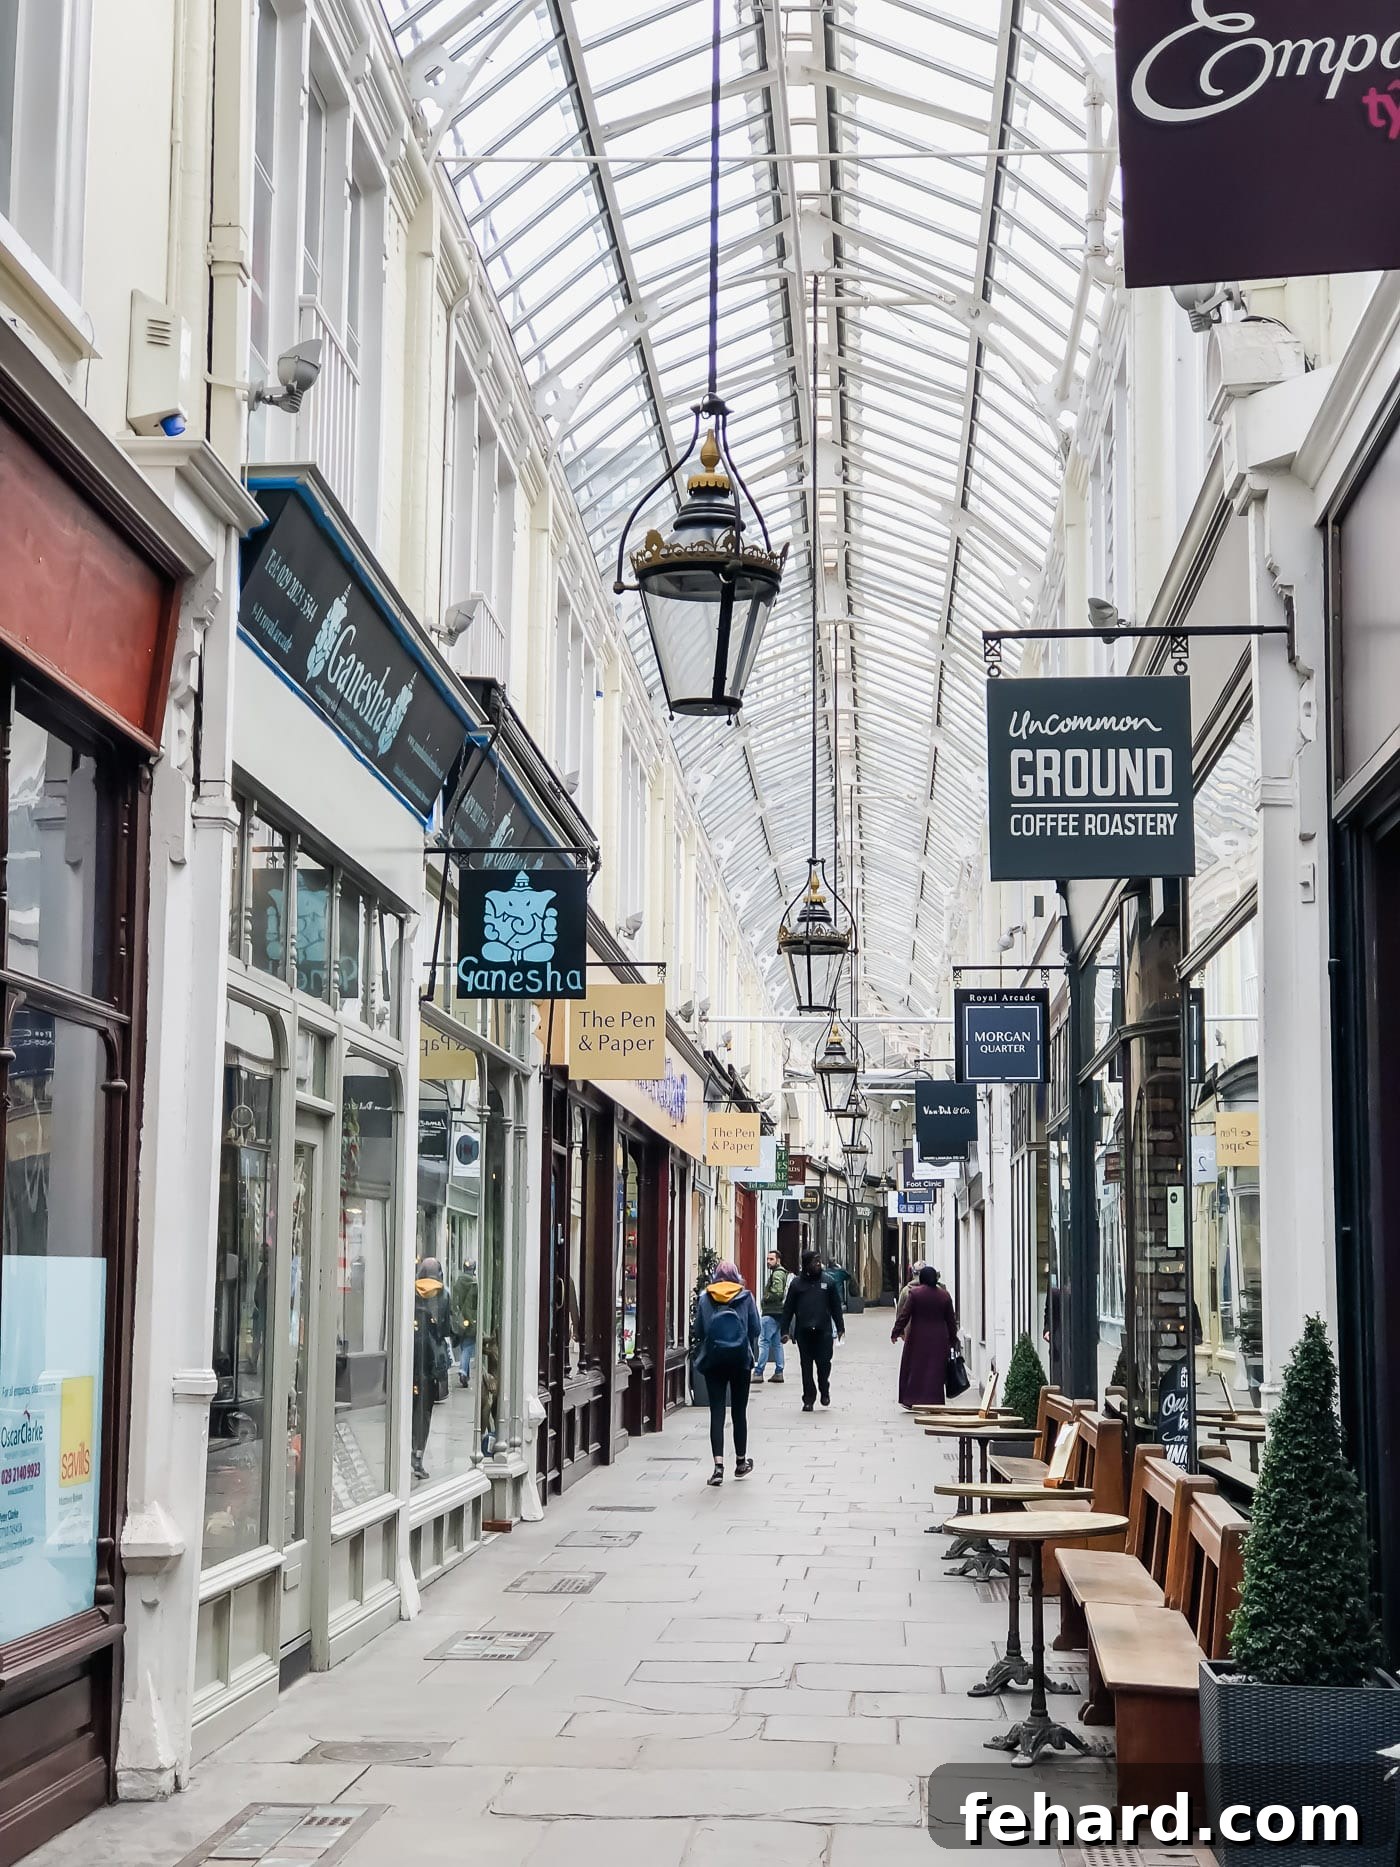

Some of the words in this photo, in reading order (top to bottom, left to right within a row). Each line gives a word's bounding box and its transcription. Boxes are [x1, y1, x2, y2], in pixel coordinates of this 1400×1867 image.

[265, 549, 281, 579] Tel:
[276, 564, 293, 589] 029
[286, 577, 306, 606] 2023
[300, 594, 318, 622] 5544
[327, 624, 392, 733] Ganesha
[1010, 748, 1173, 797] GROUND
[1010, 813, 1079, 836] COFFEE
[1084, 813, 1178, 836] ROASTERY
[457, 956, 584, 993] Ganesha
[969, 993, 998, 1003] Royal
[1001, 993, 1036, 1002] Arcade
[578, 1010, 615, 1028] The
[621, 1010, 656, 1028] Pen
[578, 1034, 593, 1051] &
[598, 1034, 655, 1056] Paper
[974, 1031, 1031, 1042] MORGAN
[980, 1044, 1026, 1053] QUARTER
[711, 1127, 732, 1138] The
[735, 1127, 755, 1138] Pen
[711, 1142, 720, 1150] &
[722, 1142, 754, 1153] Paper
[61, 1441, 90, 1480] savills
